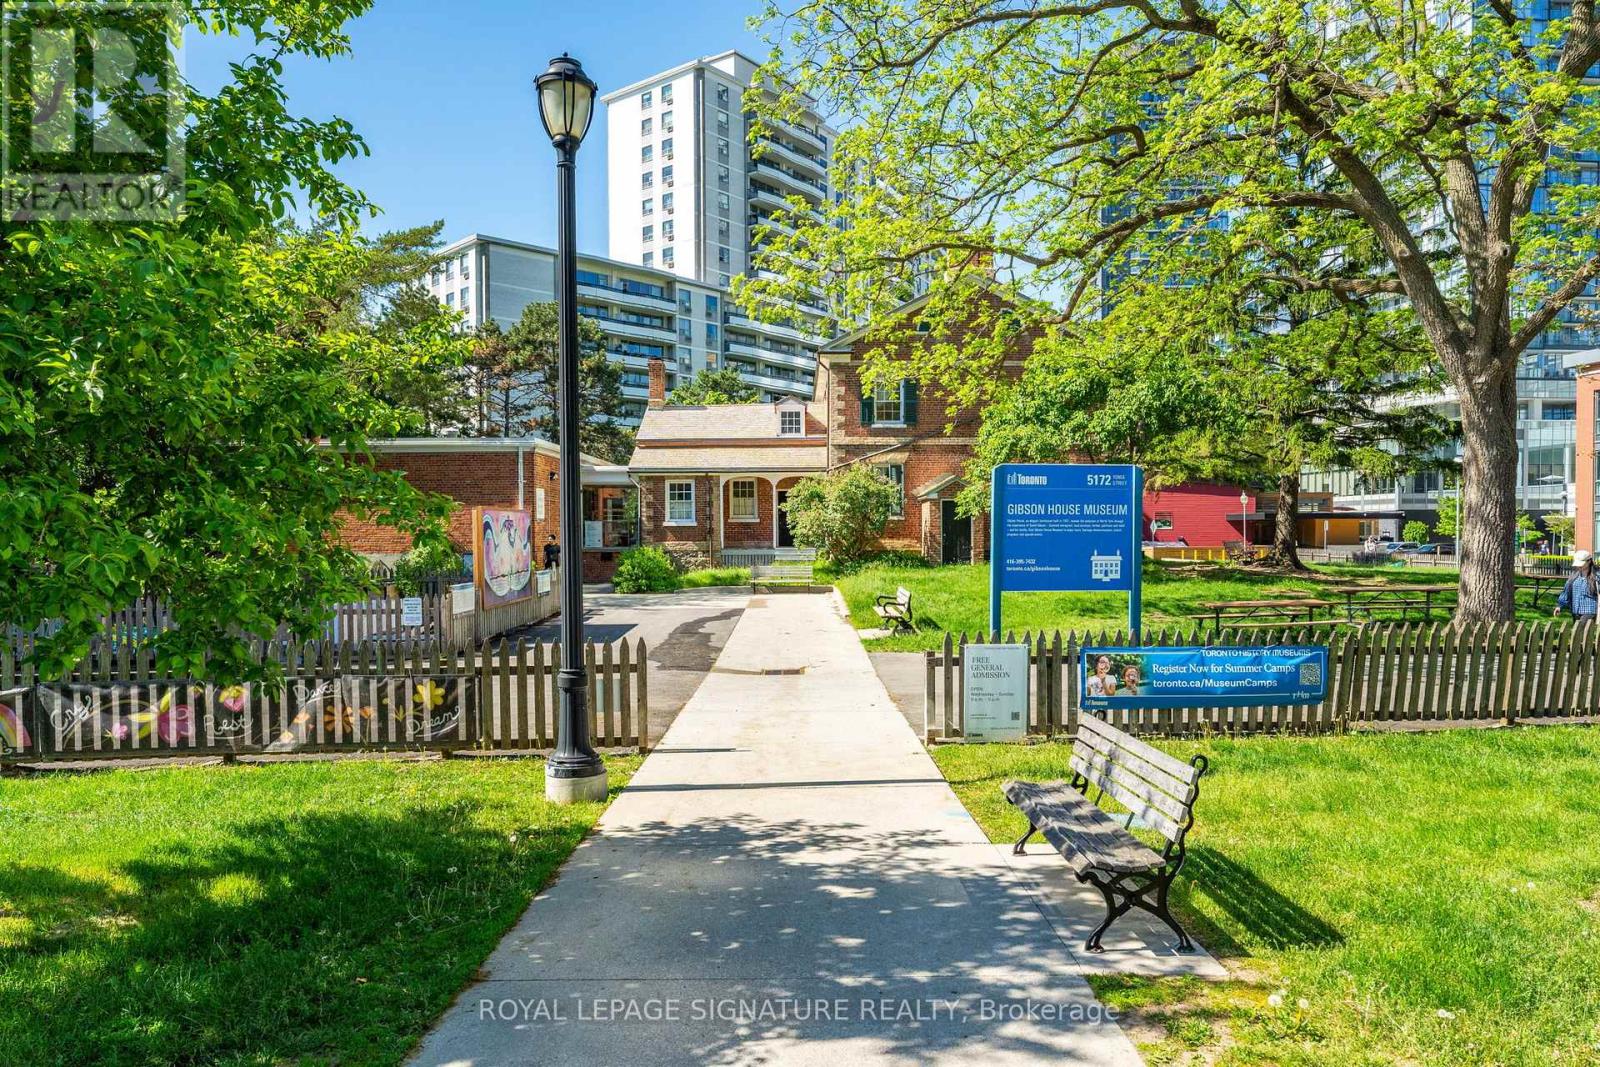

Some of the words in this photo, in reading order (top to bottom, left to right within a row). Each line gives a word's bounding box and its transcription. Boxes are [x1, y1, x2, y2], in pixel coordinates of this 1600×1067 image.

[1018, 474, 1048, 485] TORONTO
[1087, 474, 1111, 486] 5172
[1007, 503, 1045, 515] GIBSON
[1048, 503, 1081, 515] HOUSE
[1084, 504, 1128, 516] MUSEUM
[1201, 649, 1239, 657] TORONTO
[1239, 649, 1272, 657] HISTORY
[1272, 649, 1311, 657] MUSEUMS
[1152, 663, 1187, 675] Register
[1189, 664, 1208, 673] Now
[1211, 663, 1223, 673] for
[1225, 663, 1262, 673] Summer
[1263, 662, 1296, 675] Camps
[972, 671, 1010, 679] ADMISSION
[1153, 678, 1278, 689] toronto.ca/MuseumCamps
[203, 714, 254, 736] Rest
